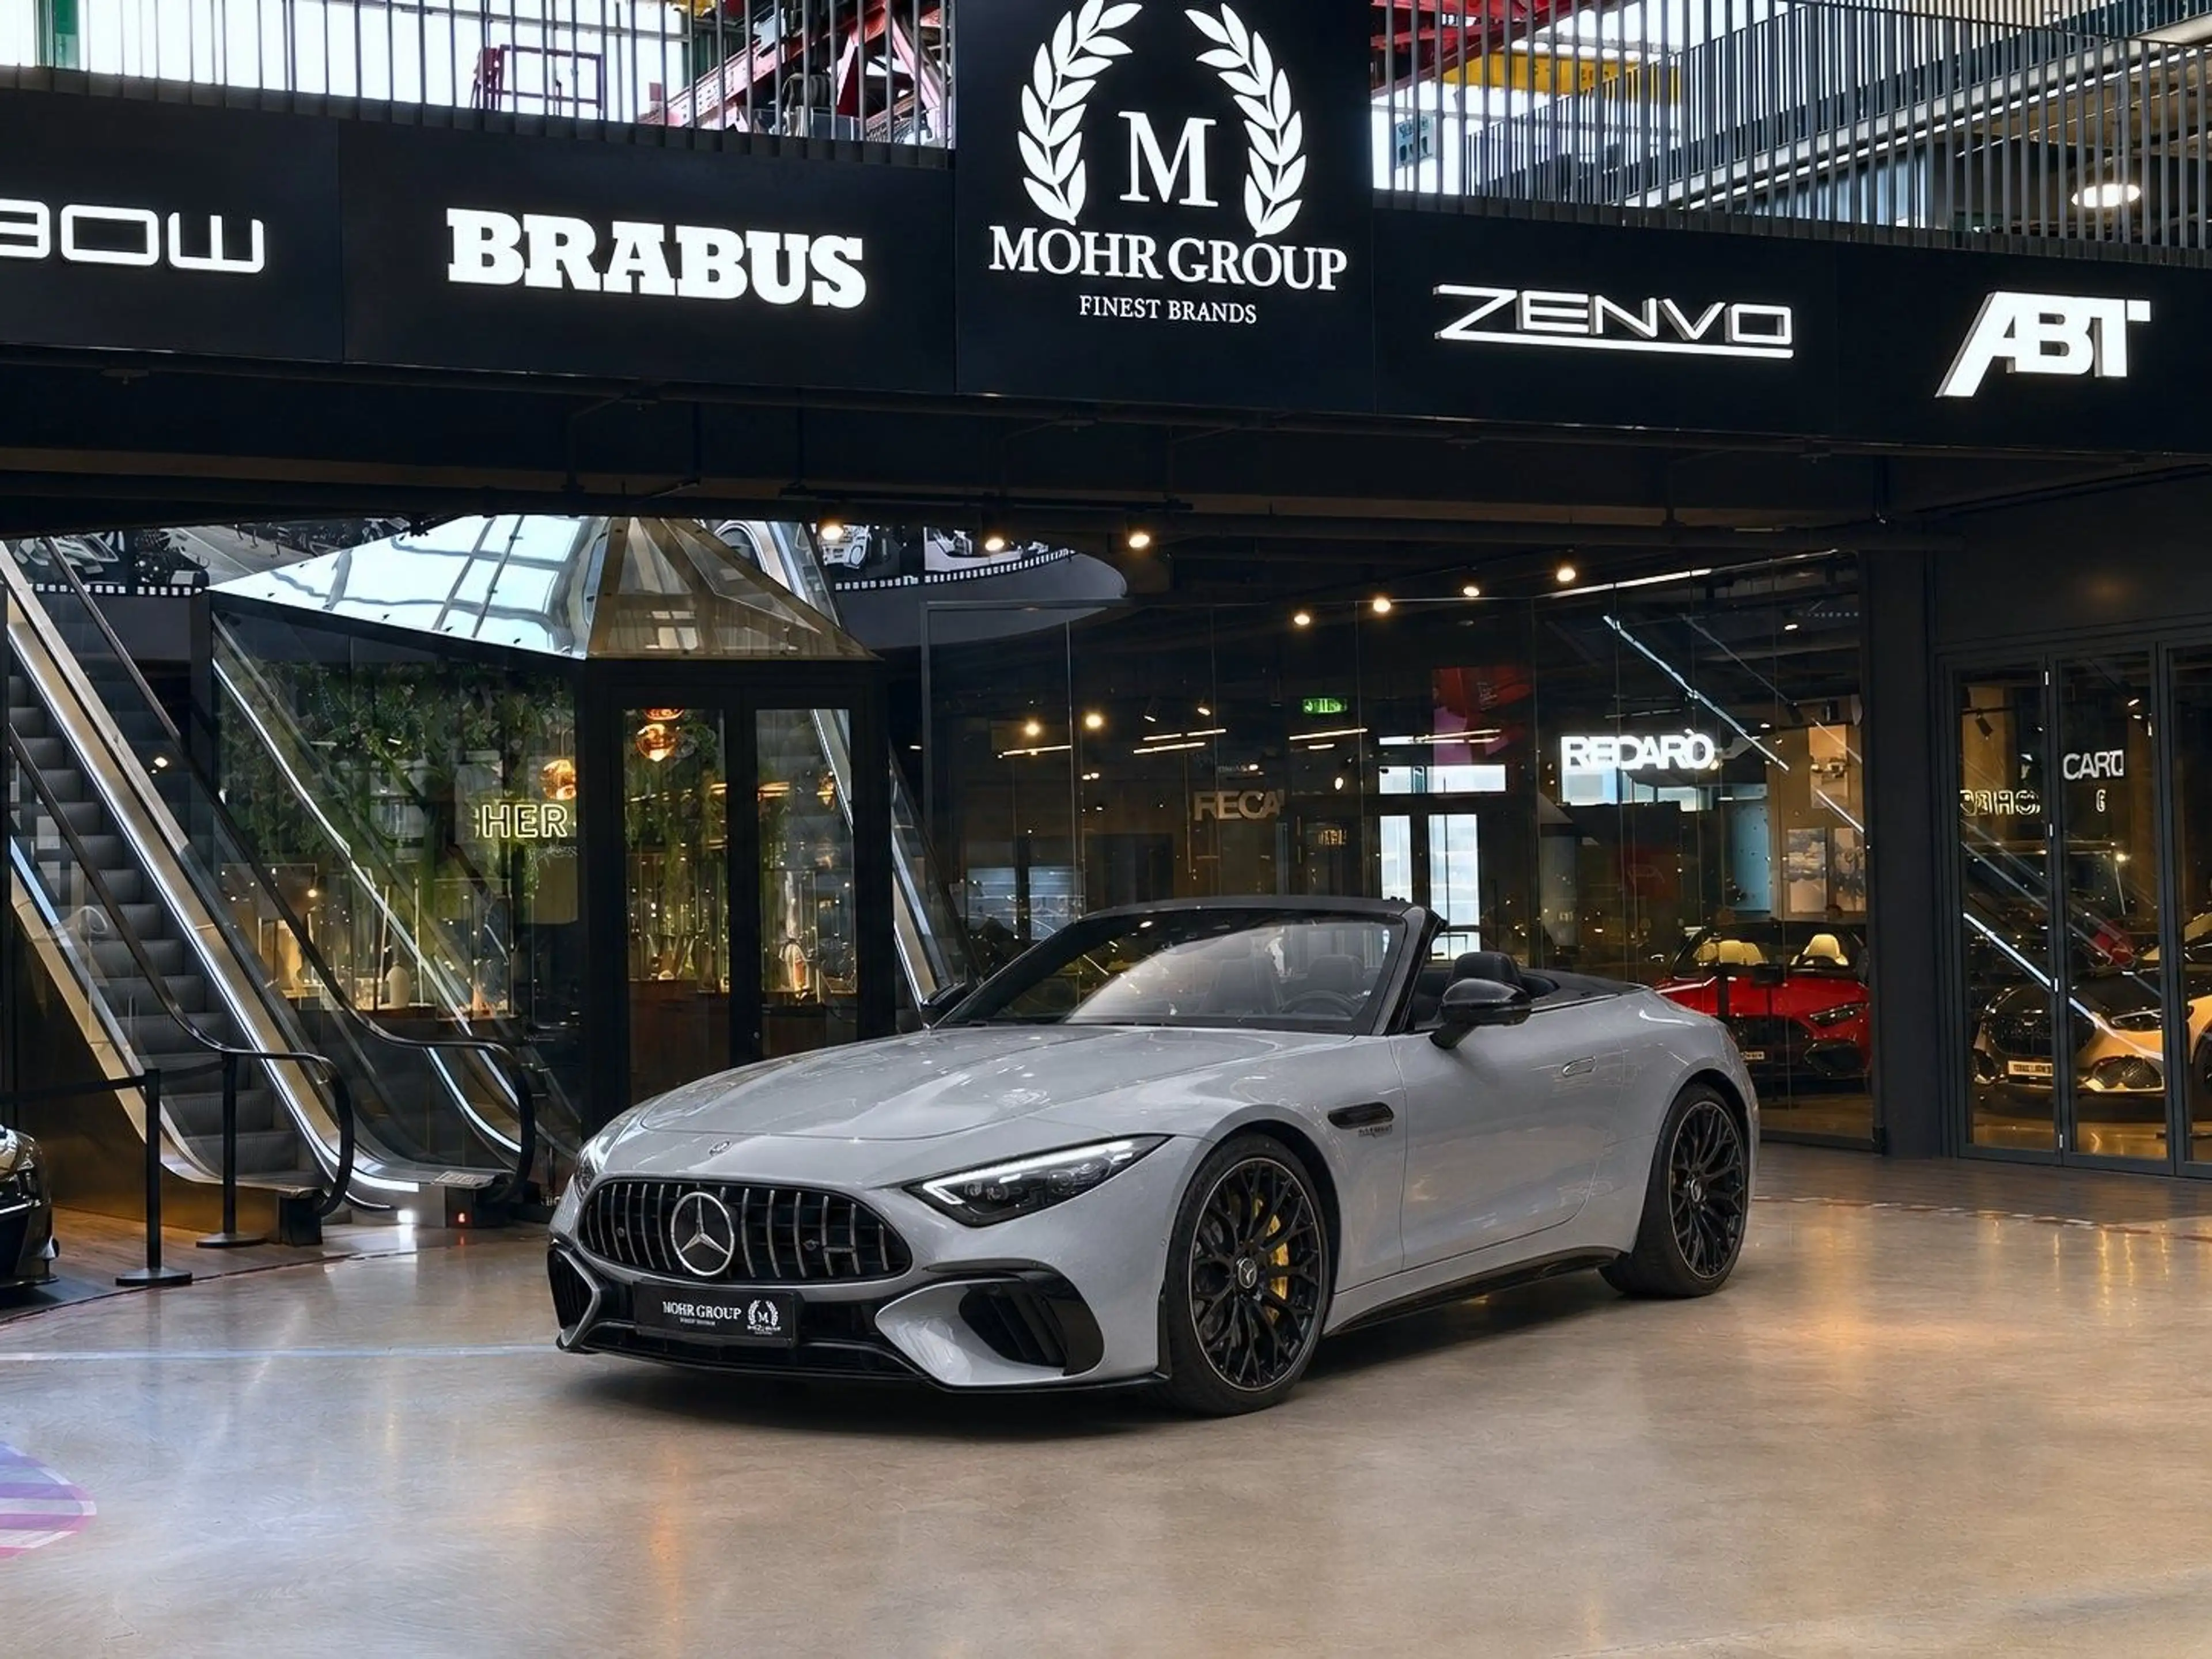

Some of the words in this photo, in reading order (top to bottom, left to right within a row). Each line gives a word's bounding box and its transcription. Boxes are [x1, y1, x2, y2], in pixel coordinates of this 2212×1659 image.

[1119, 111, 1219, 208] M
[446, 208, 867, 309] BRABUS
[988, 226, 1163, 280] MOHR
[1168, 237, 1348, 291] GROUP
[1079, 295, 1161, 320] FINEST
[1168, 300, 1257, 324] BRANDS
[1433, 284, 1794, 359] ZENVO
[1934, 291, 2152, 398] ABT
[696, 1305, 742, 1320] GROUP
